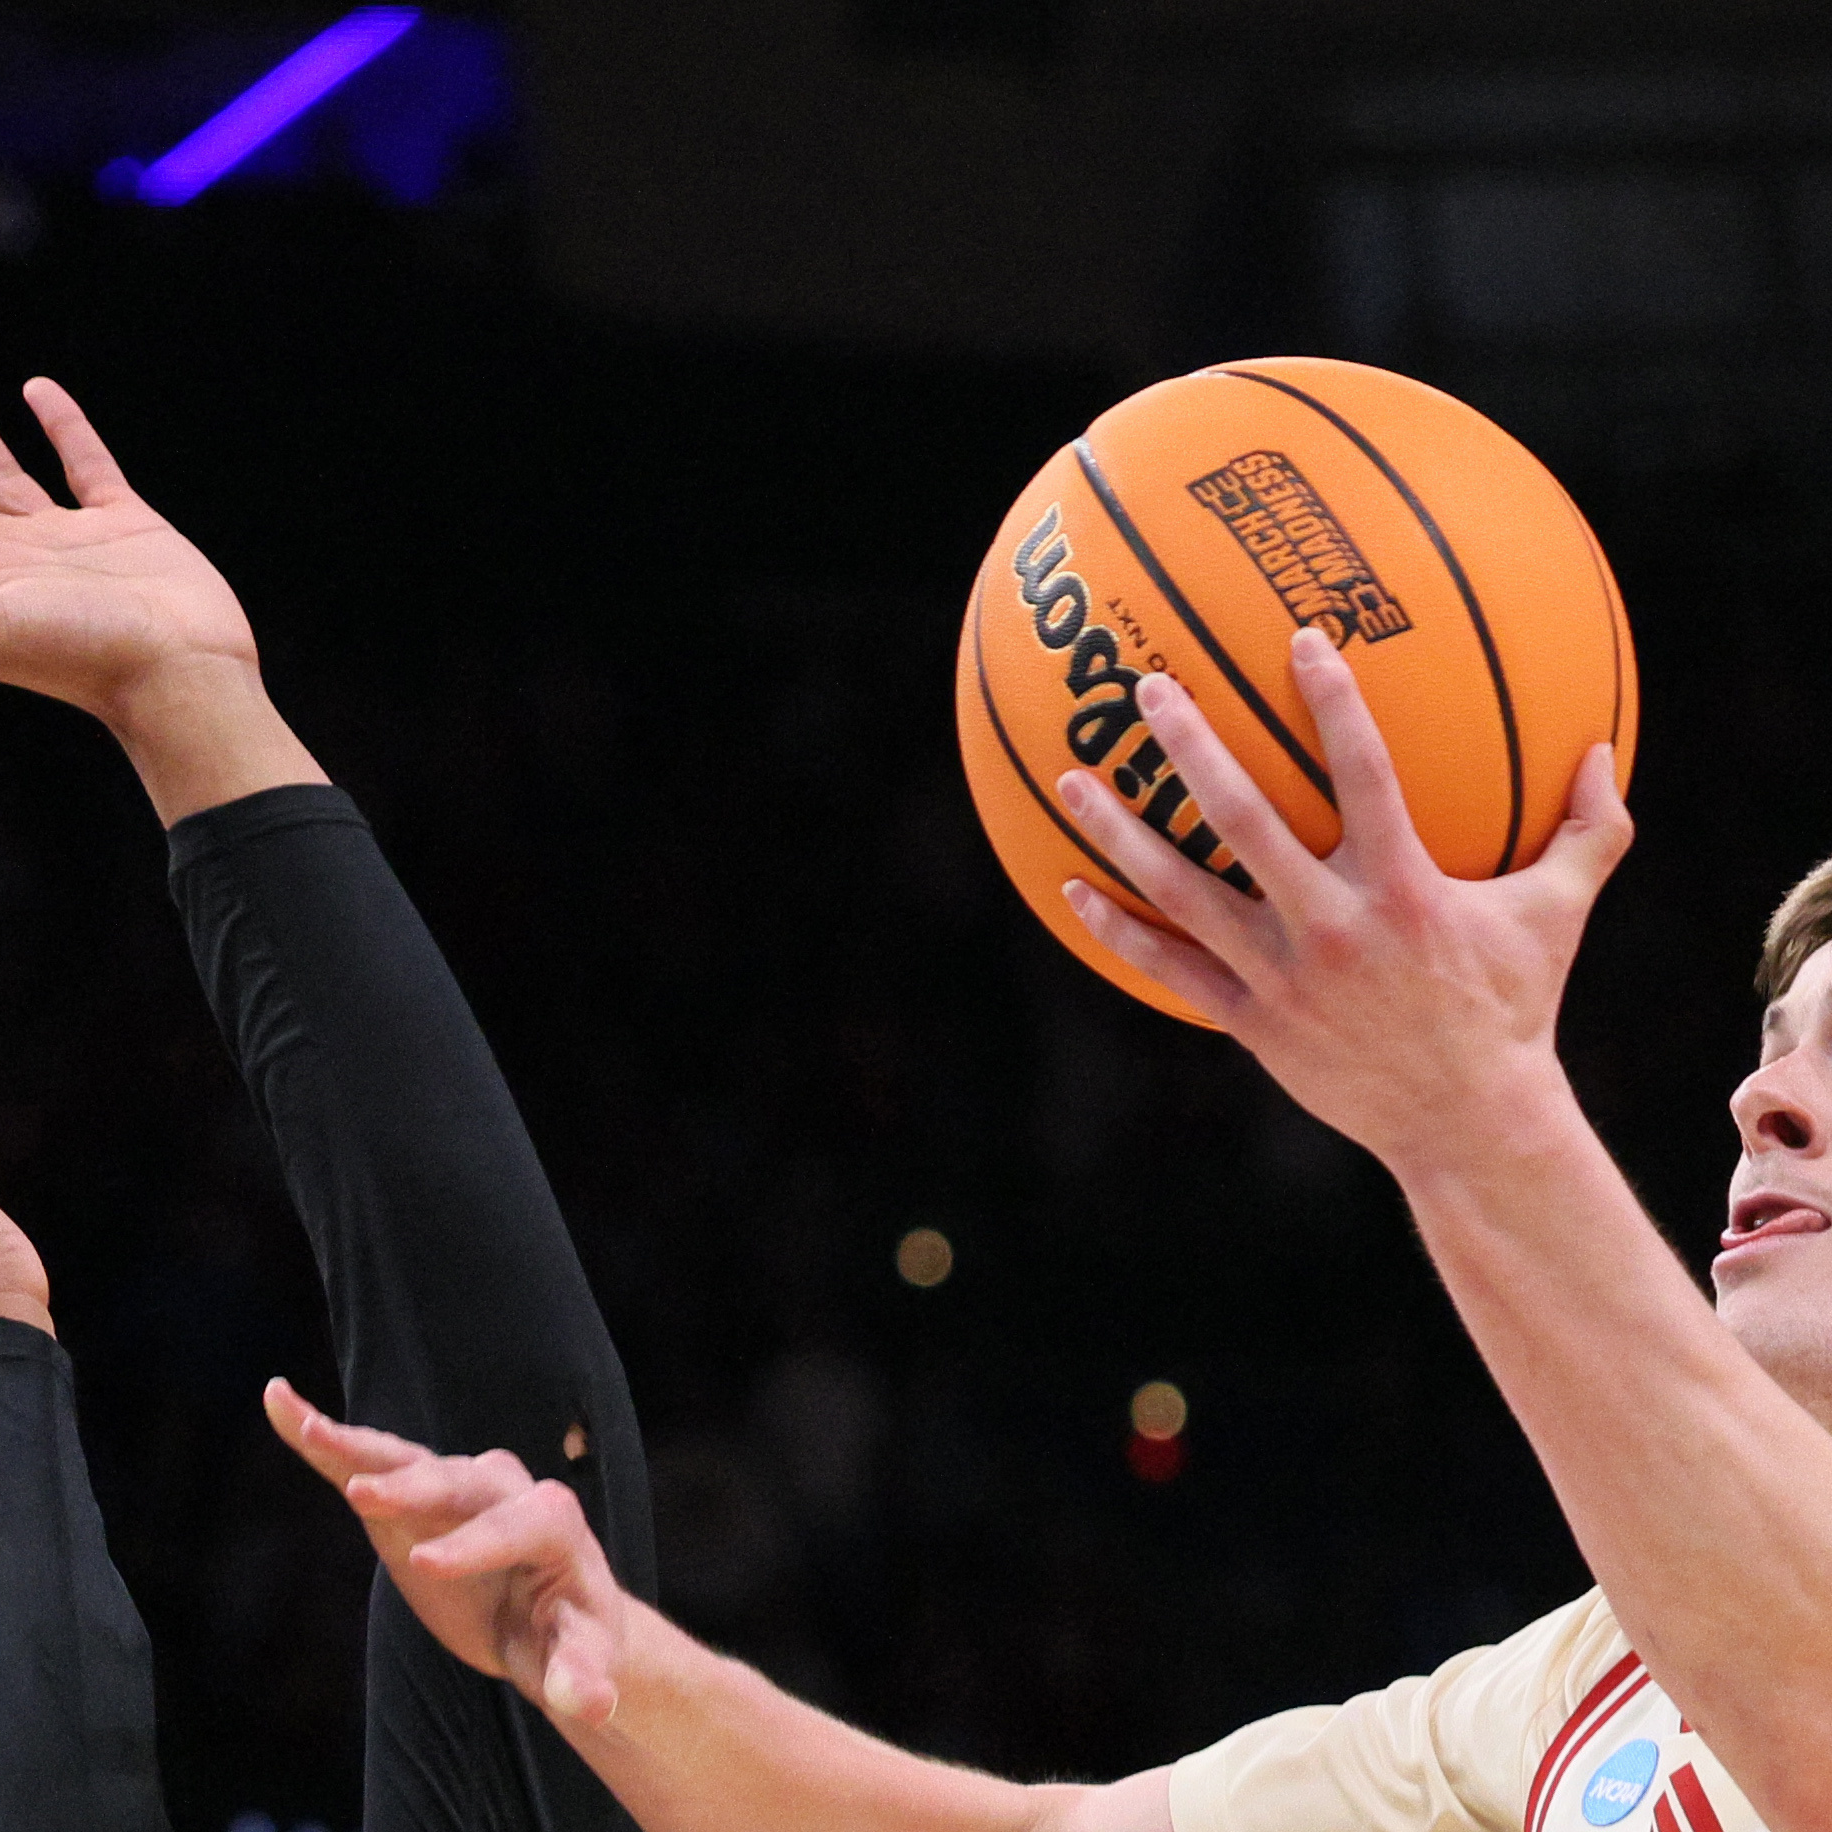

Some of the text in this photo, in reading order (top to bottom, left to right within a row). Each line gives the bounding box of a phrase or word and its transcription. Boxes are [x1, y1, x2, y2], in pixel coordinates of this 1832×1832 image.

[1230, 508, 1337, 619] MARCH
[1231, 452, 1357, 586] MADNESS
[1588, 1776, 1644, 1805] NCAA
